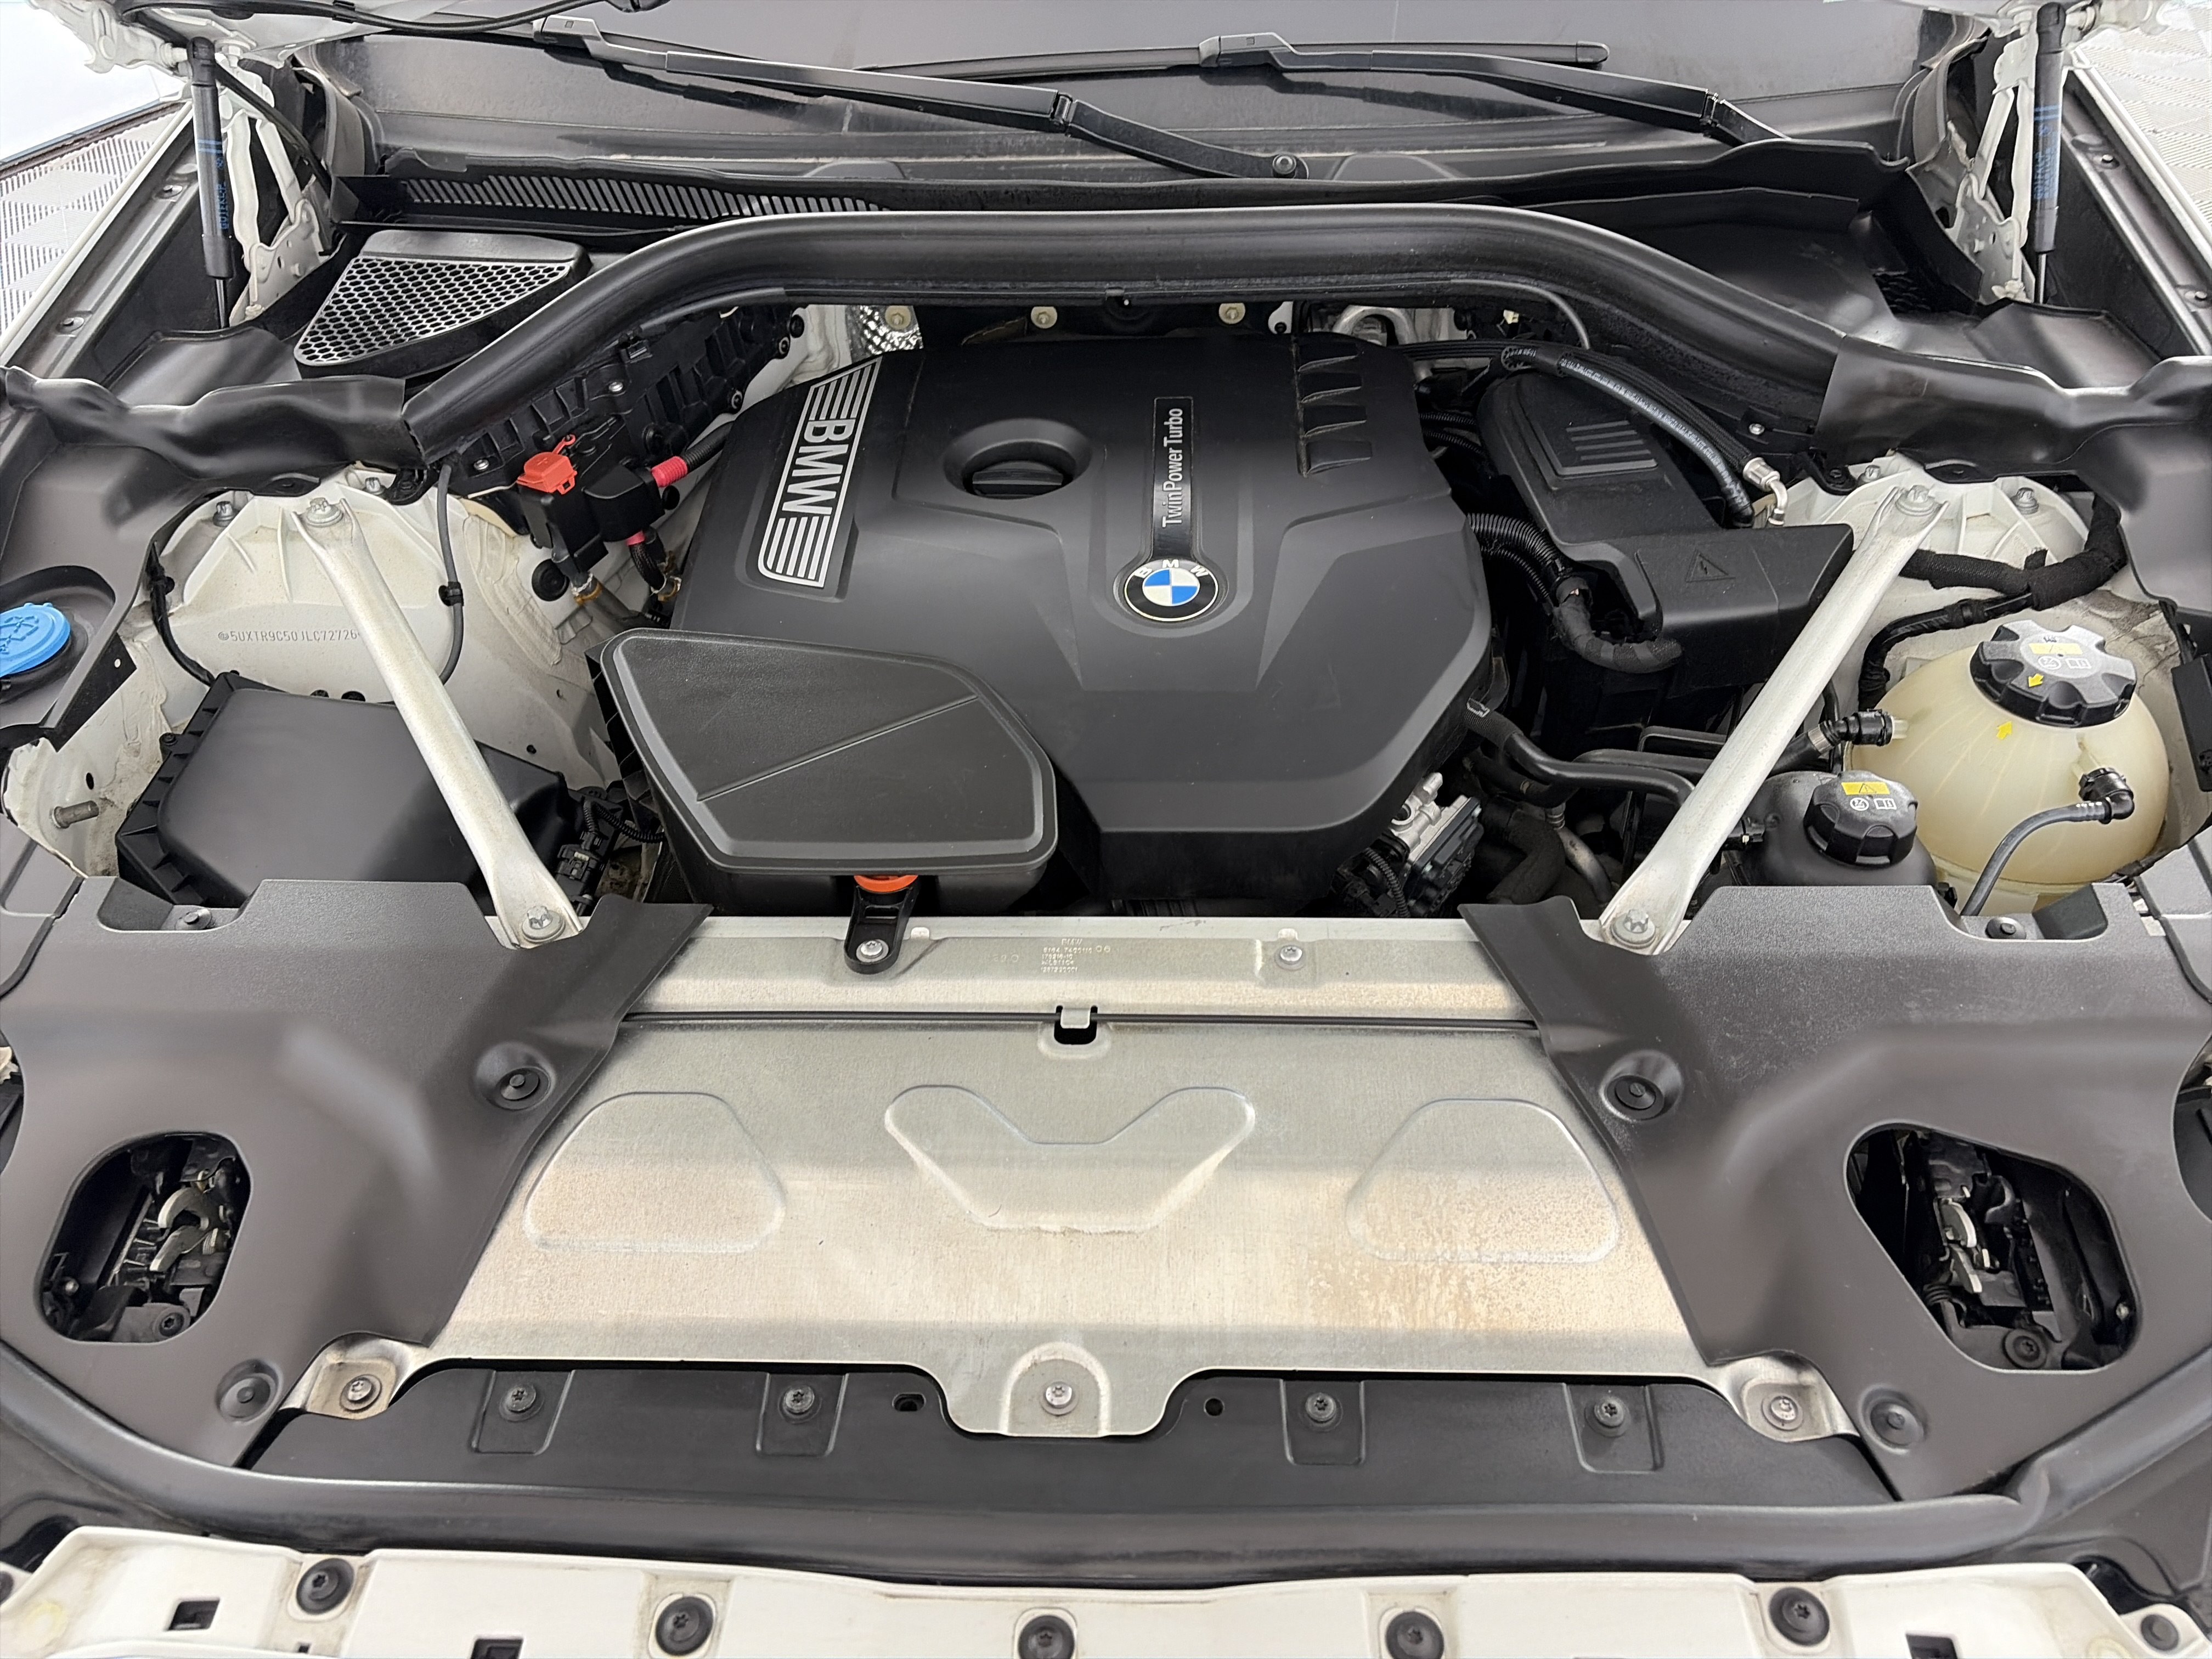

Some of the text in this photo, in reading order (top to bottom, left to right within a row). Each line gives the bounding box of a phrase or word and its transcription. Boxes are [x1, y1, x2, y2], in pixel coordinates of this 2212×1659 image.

[782, 417, 856, 515] BMW
[1162, 408, 1183, 527] TwinPower Turbo
[1133, 559, 1209, 579] BMW
